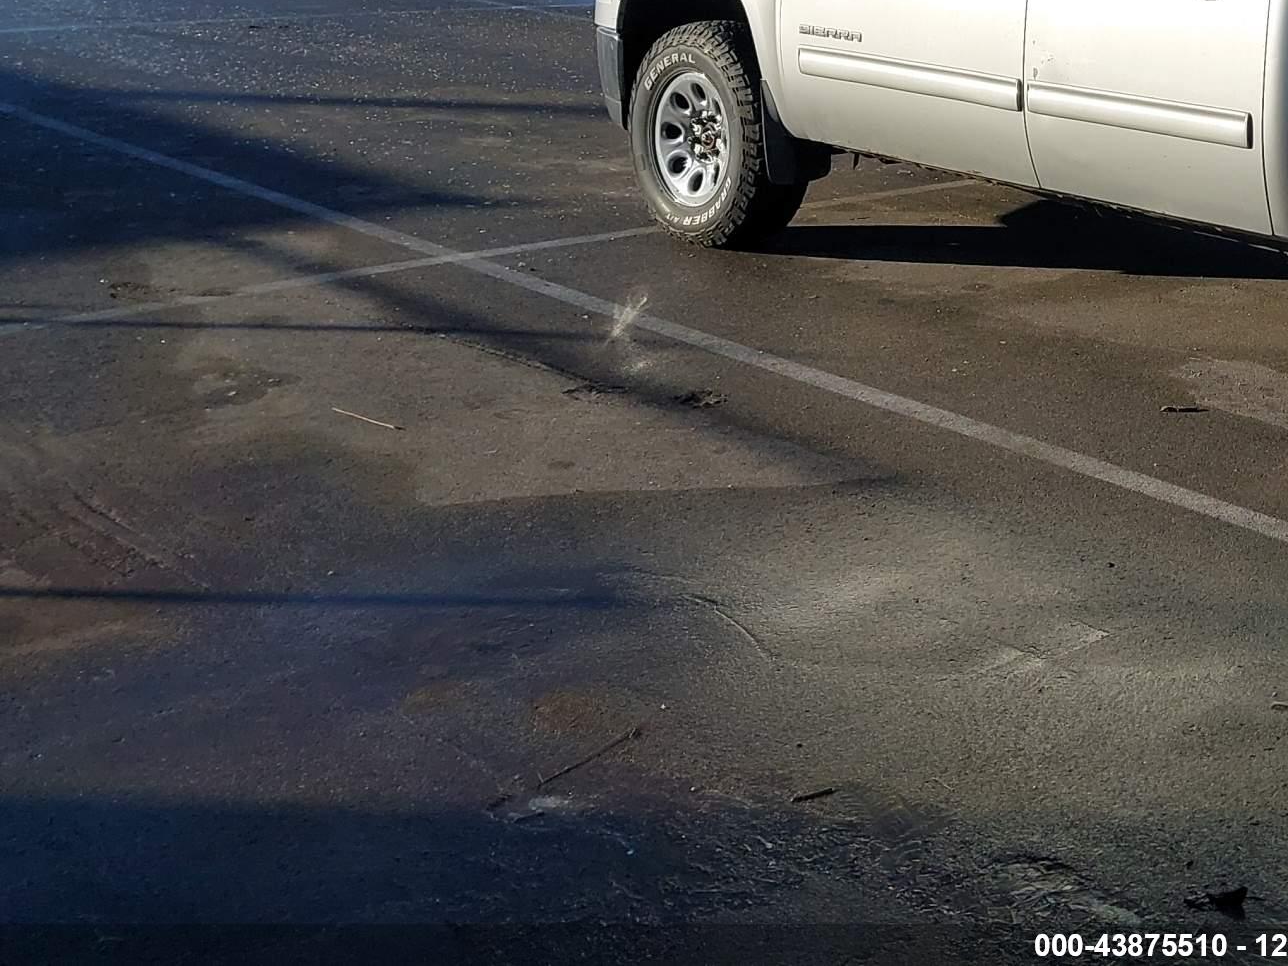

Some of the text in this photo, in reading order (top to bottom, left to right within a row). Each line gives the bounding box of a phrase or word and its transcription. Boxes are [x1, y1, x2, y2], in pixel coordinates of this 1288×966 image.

[799, 24, 863, 43] SIERRA
[643, 52, 696, 91] GENERAL
[682, 176, 731, 226] GRABBER
